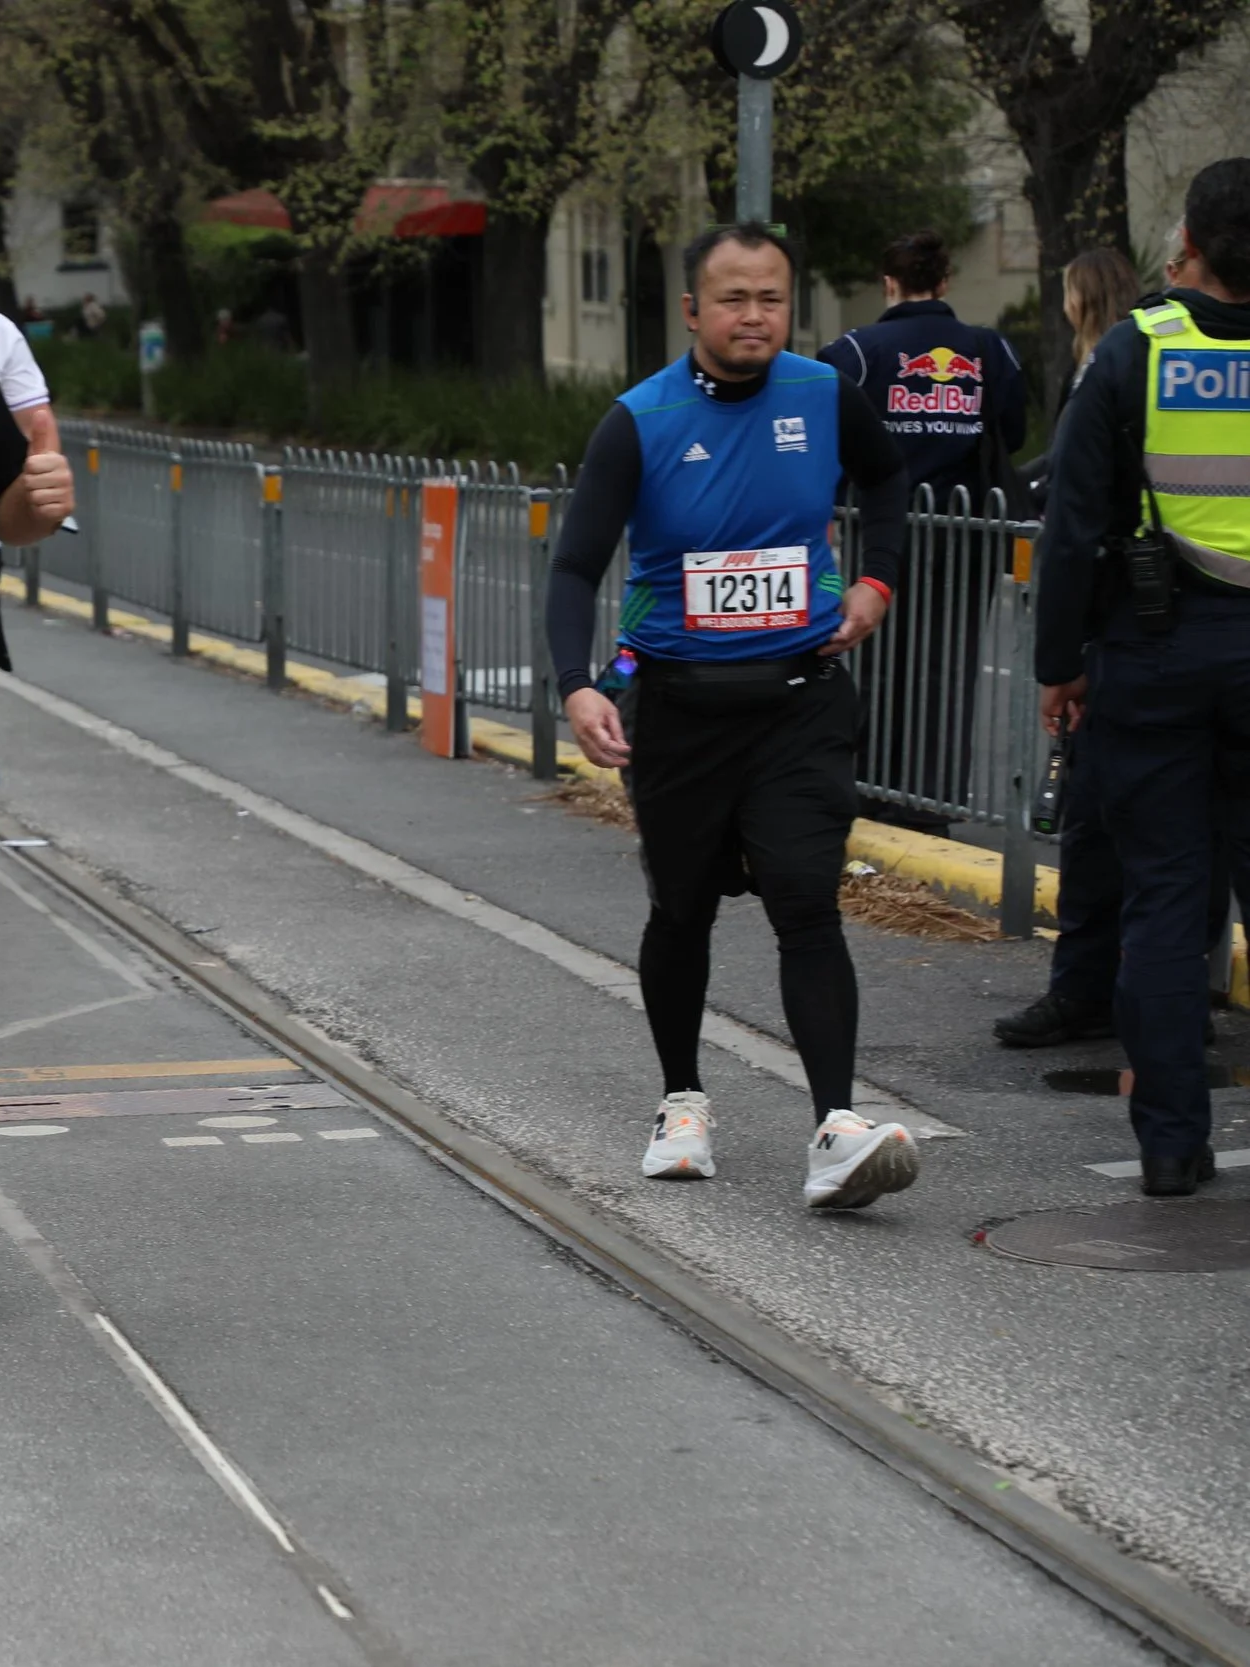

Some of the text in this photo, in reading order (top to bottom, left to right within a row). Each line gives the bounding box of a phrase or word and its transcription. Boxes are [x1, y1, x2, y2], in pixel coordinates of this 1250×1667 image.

[1163, 359, 1250, 399] Poli
[888, 384, 943, 413] Red
[925, 420, 955, 433] YOU
[705, 571, 794, 613] 12314
[696, 613, 799, 629] MELBOURNE 2025
